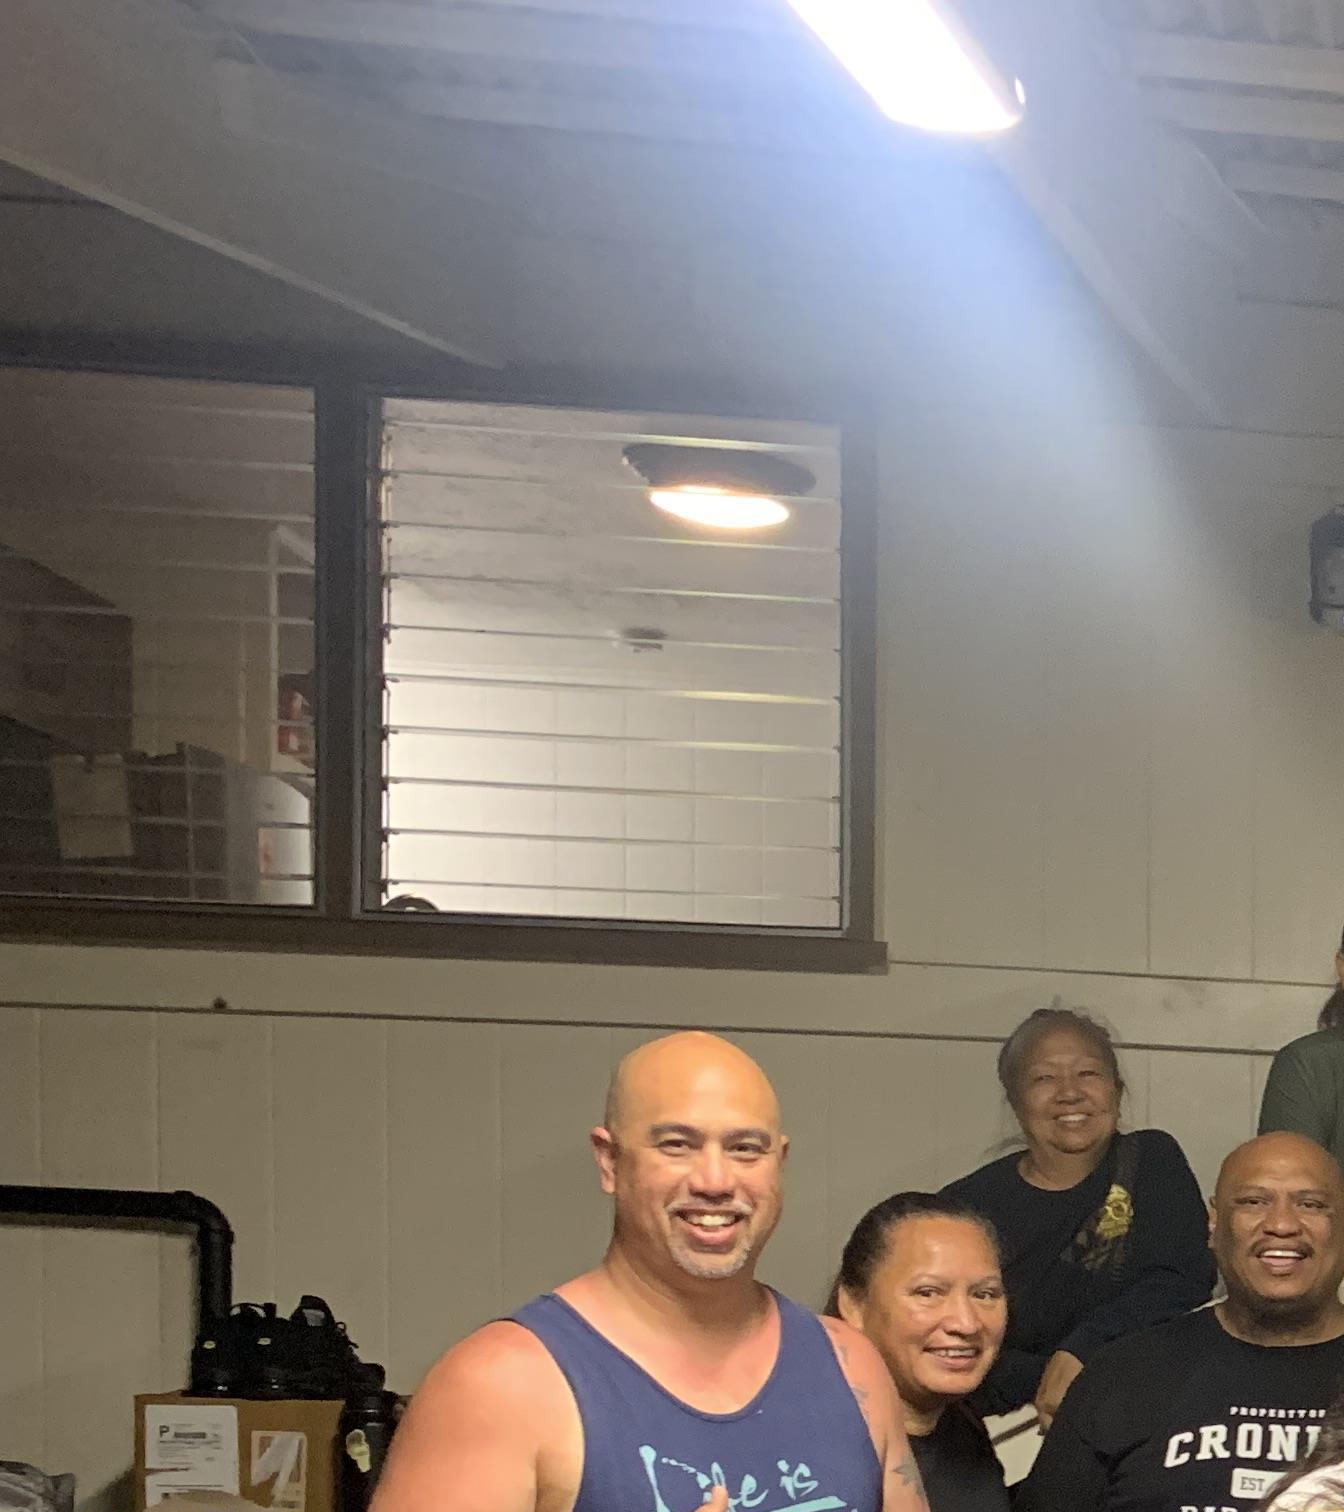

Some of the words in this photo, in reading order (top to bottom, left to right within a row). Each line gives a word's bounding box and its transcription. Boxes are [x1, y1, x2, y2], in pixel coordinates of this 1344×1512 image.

[159, 1425, 170, 1438] P
[777, 1459, 818, 1500] is
[1240, 1477, 1265, 1491] EST
